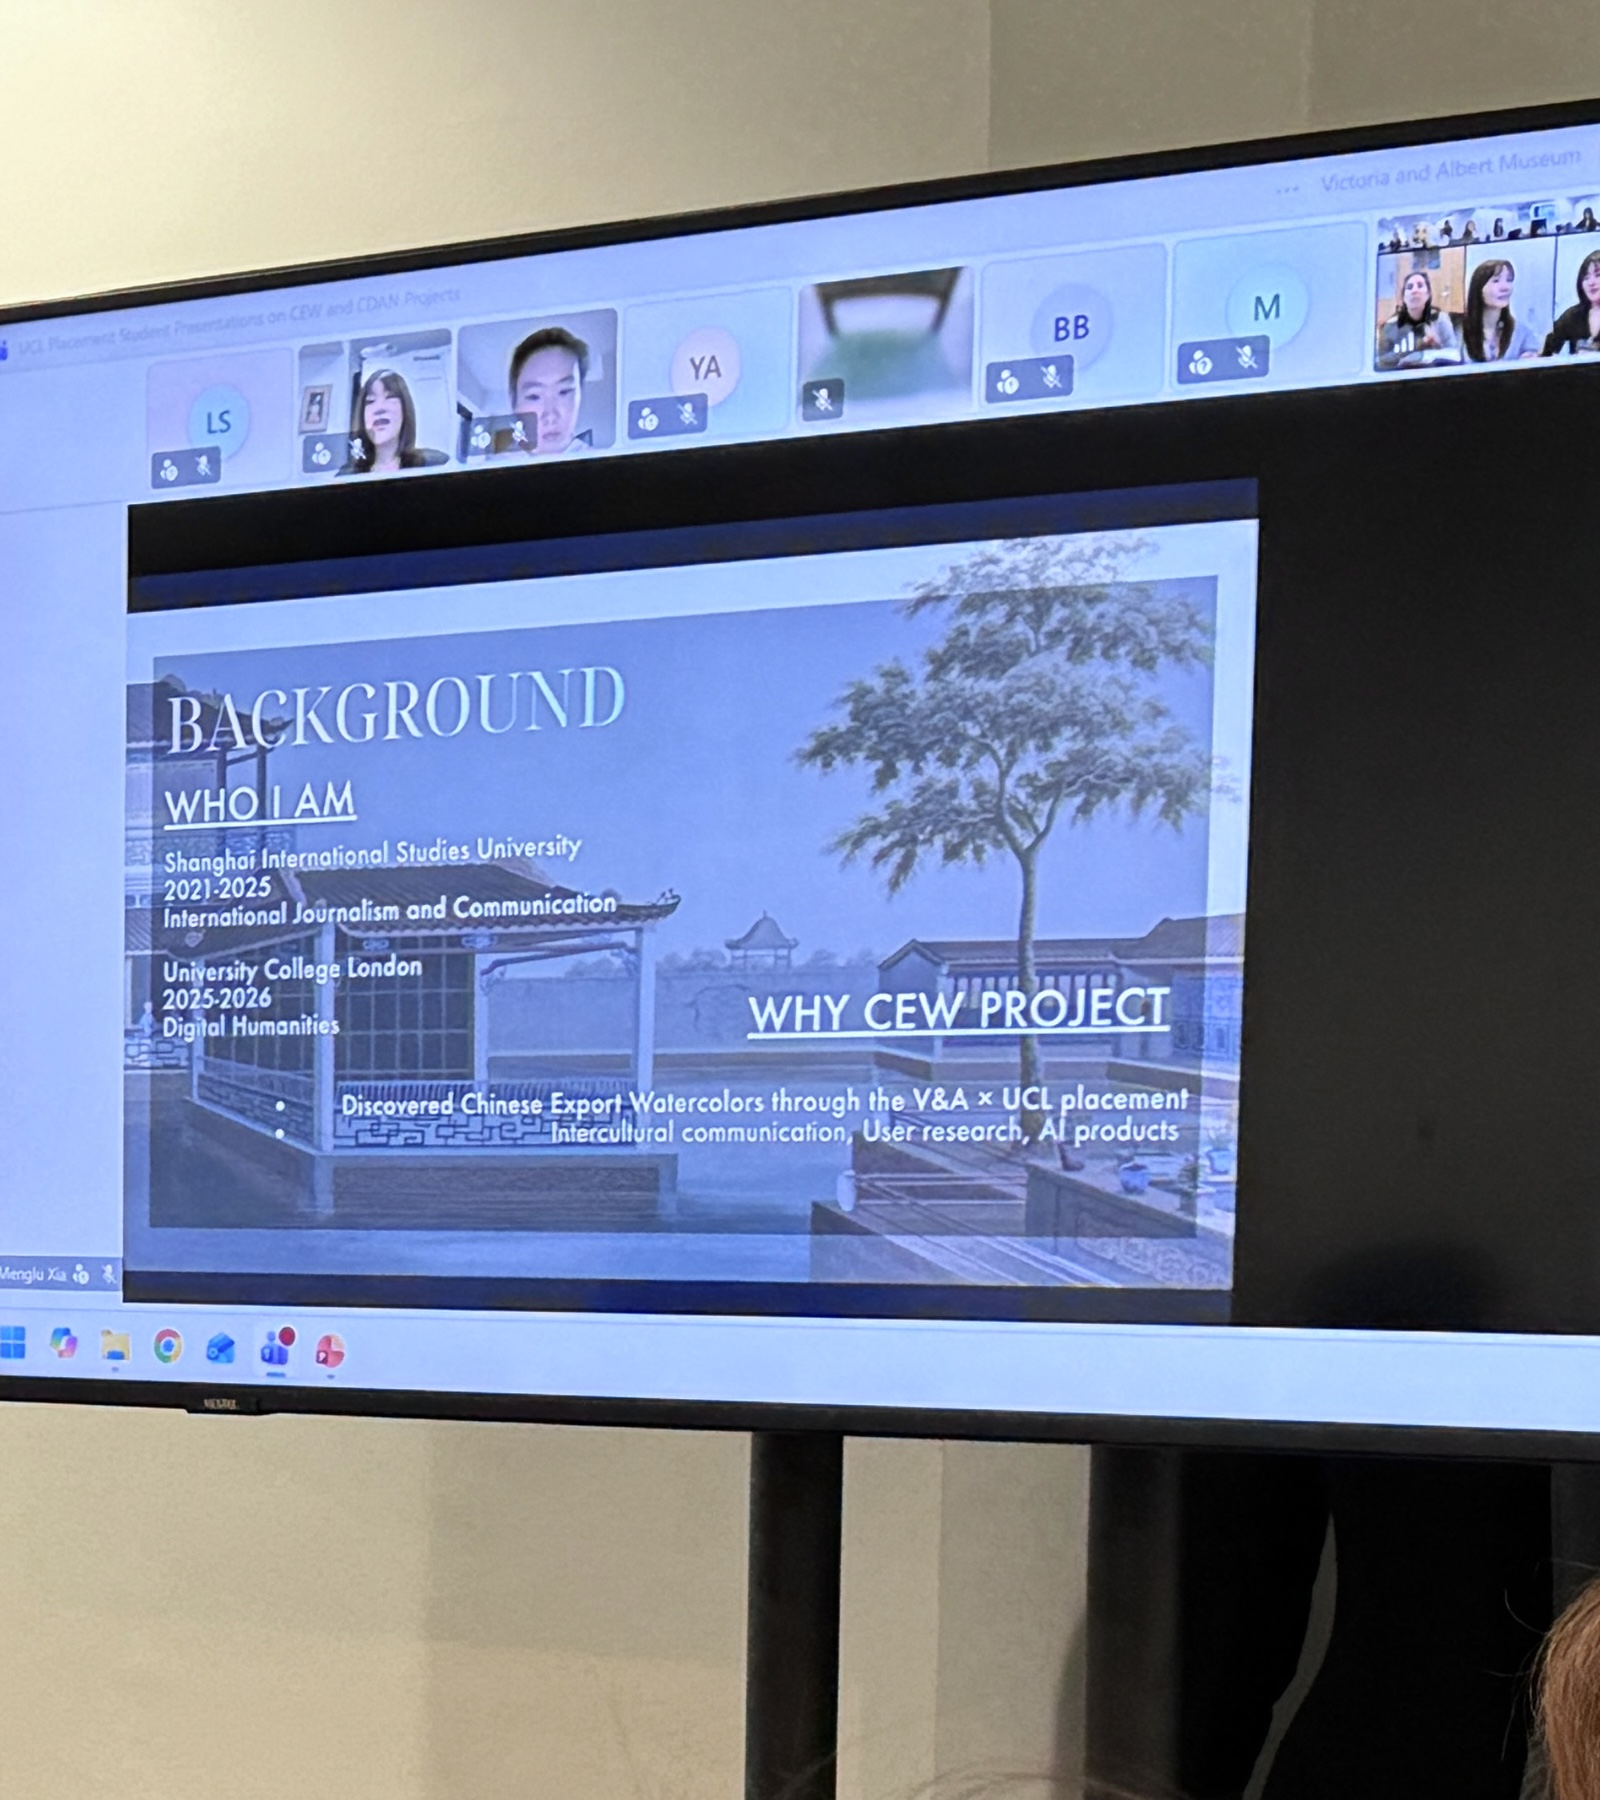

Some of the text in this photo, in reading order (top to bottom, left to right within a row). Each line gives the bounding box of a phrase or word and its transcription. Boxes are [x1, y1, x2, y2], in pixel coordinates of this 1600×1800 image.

[1321, 149, 1582, 191] Victoria and Albert Museum
[1254, 295, 1281, 322] M
[1053, 314, 1090, 343] BB
[690, 355, 721, 381] YA
[206, 409, 231, 434] LS
[167, 665, 625, 754] BACKGROUND
[164, 780, 355, 824] WHO I AM
[164, 835, 582, 877] Shanghai International Studies University
[164, 877, 271, 901] 2021-2025
[164, 893, 618, 929] International Journalism and Communication
[163, 955, 423, 985] University College London
[162, 987, 272, 1010] 2025-2026
[748, 986, 1171, 1033] WHY CEW PROJECT
[163, 1012, 341, 1041] Digital Humanities
[342, 1092, 453, 1116] Discovered
[461, 1092, 543, 1116] Chinese
[551, 1091, 624, 1121] Export
[629, 1089, 765, 1114] Watercolors
[772, 1087, 861, 1118] through
[868, 1087, 905, 1113] the
[913, 1087, 969, 1113] V&A
[1002, 1086, 1053, 1112] UCL
[1060, 1085, 1189, 1117] placement
[551, 1117, 1180, 1147] Intercultural communication, User research, AI products
